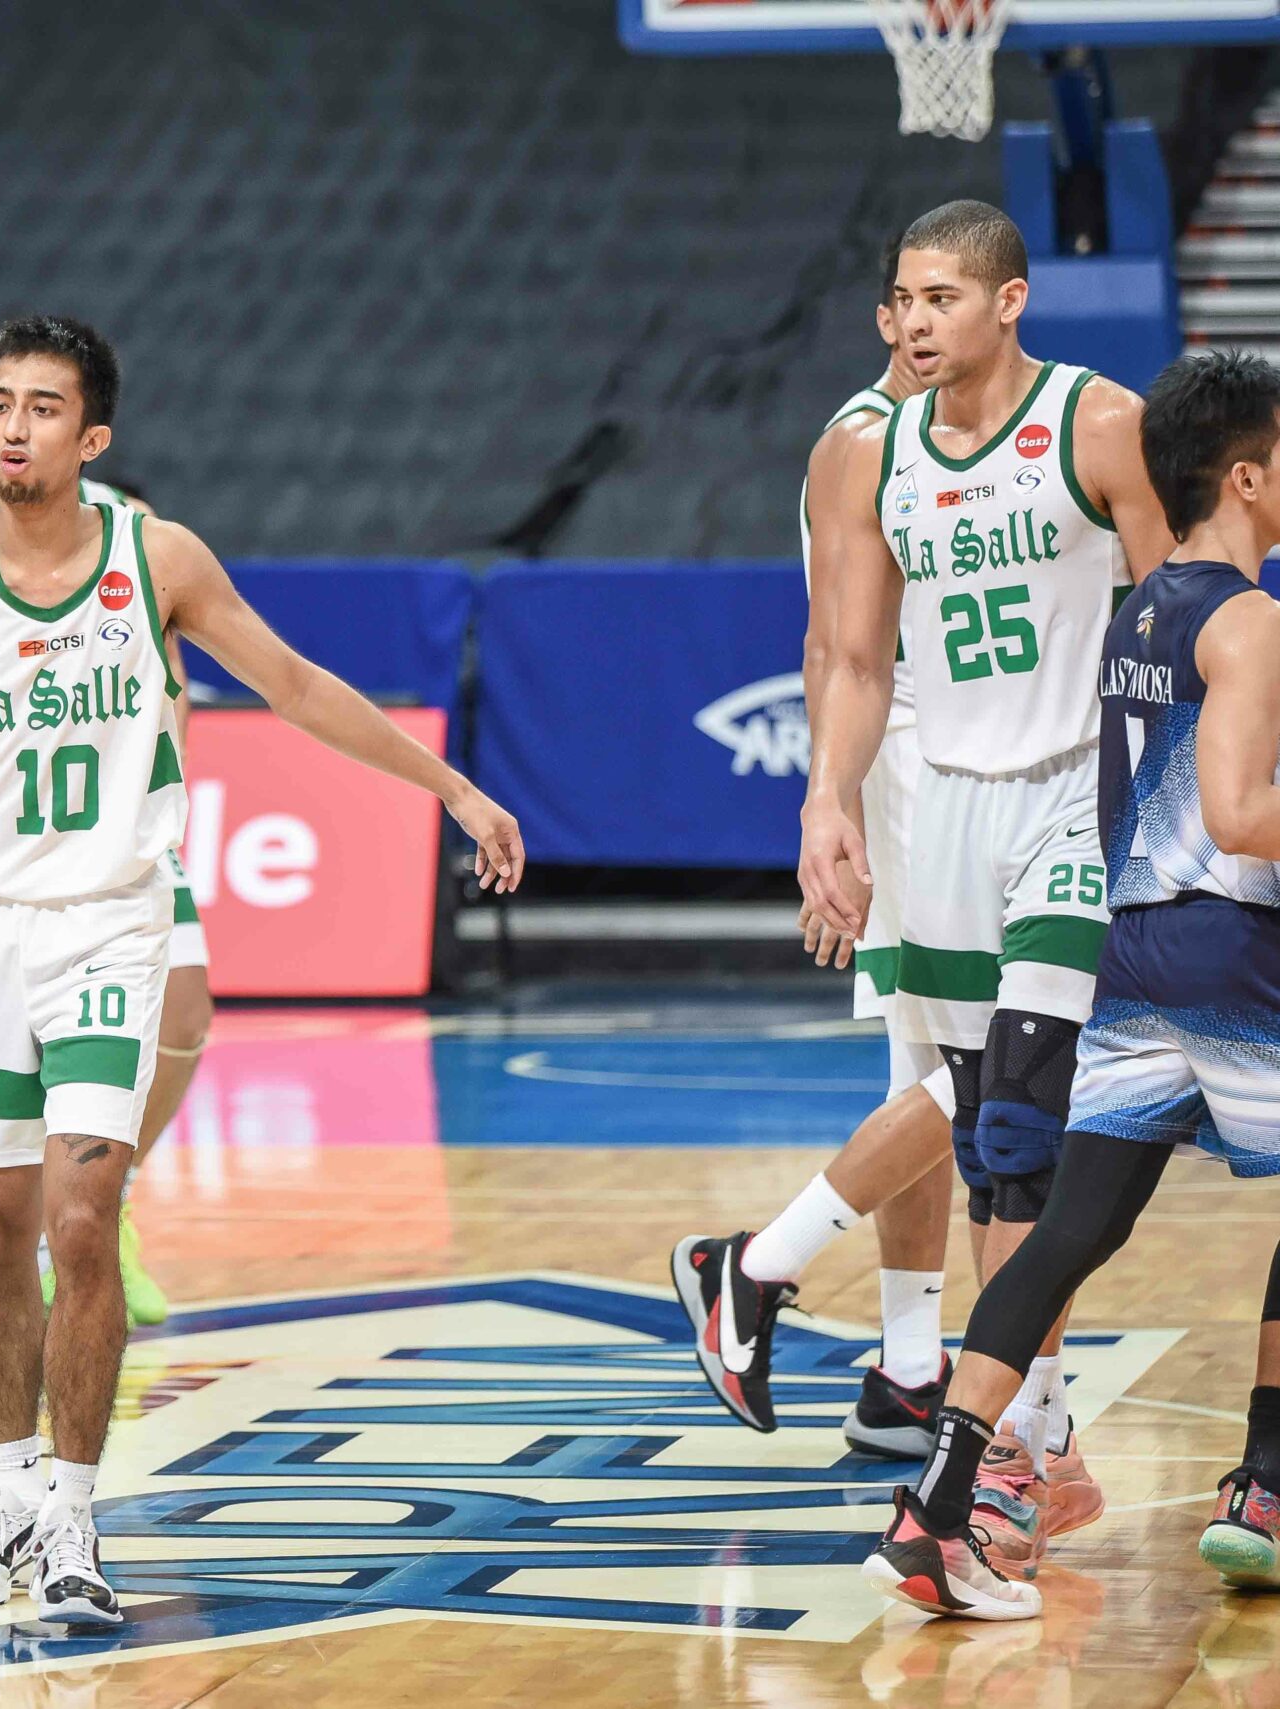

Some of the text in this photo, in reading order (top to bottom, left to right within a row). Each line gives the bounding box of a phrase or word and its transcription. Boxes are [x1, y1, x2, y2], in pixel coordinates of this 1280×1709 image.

[1018, 437, 1049, 448] Gazz
[961, 485, 995, 502] ICTSI
[892, 508, 1061, 584] La Salle
[100, 585, 131, 597] Gazz
[46, 635, 85, 652] ICTSI
[940, 584, 1040, 683] 25
[27, 663, 142, 730] Salle
[16, 744, 100, 835] 10
[1047, 864, 1105, 907] 25
[78, 986, 126, 1028] 10
